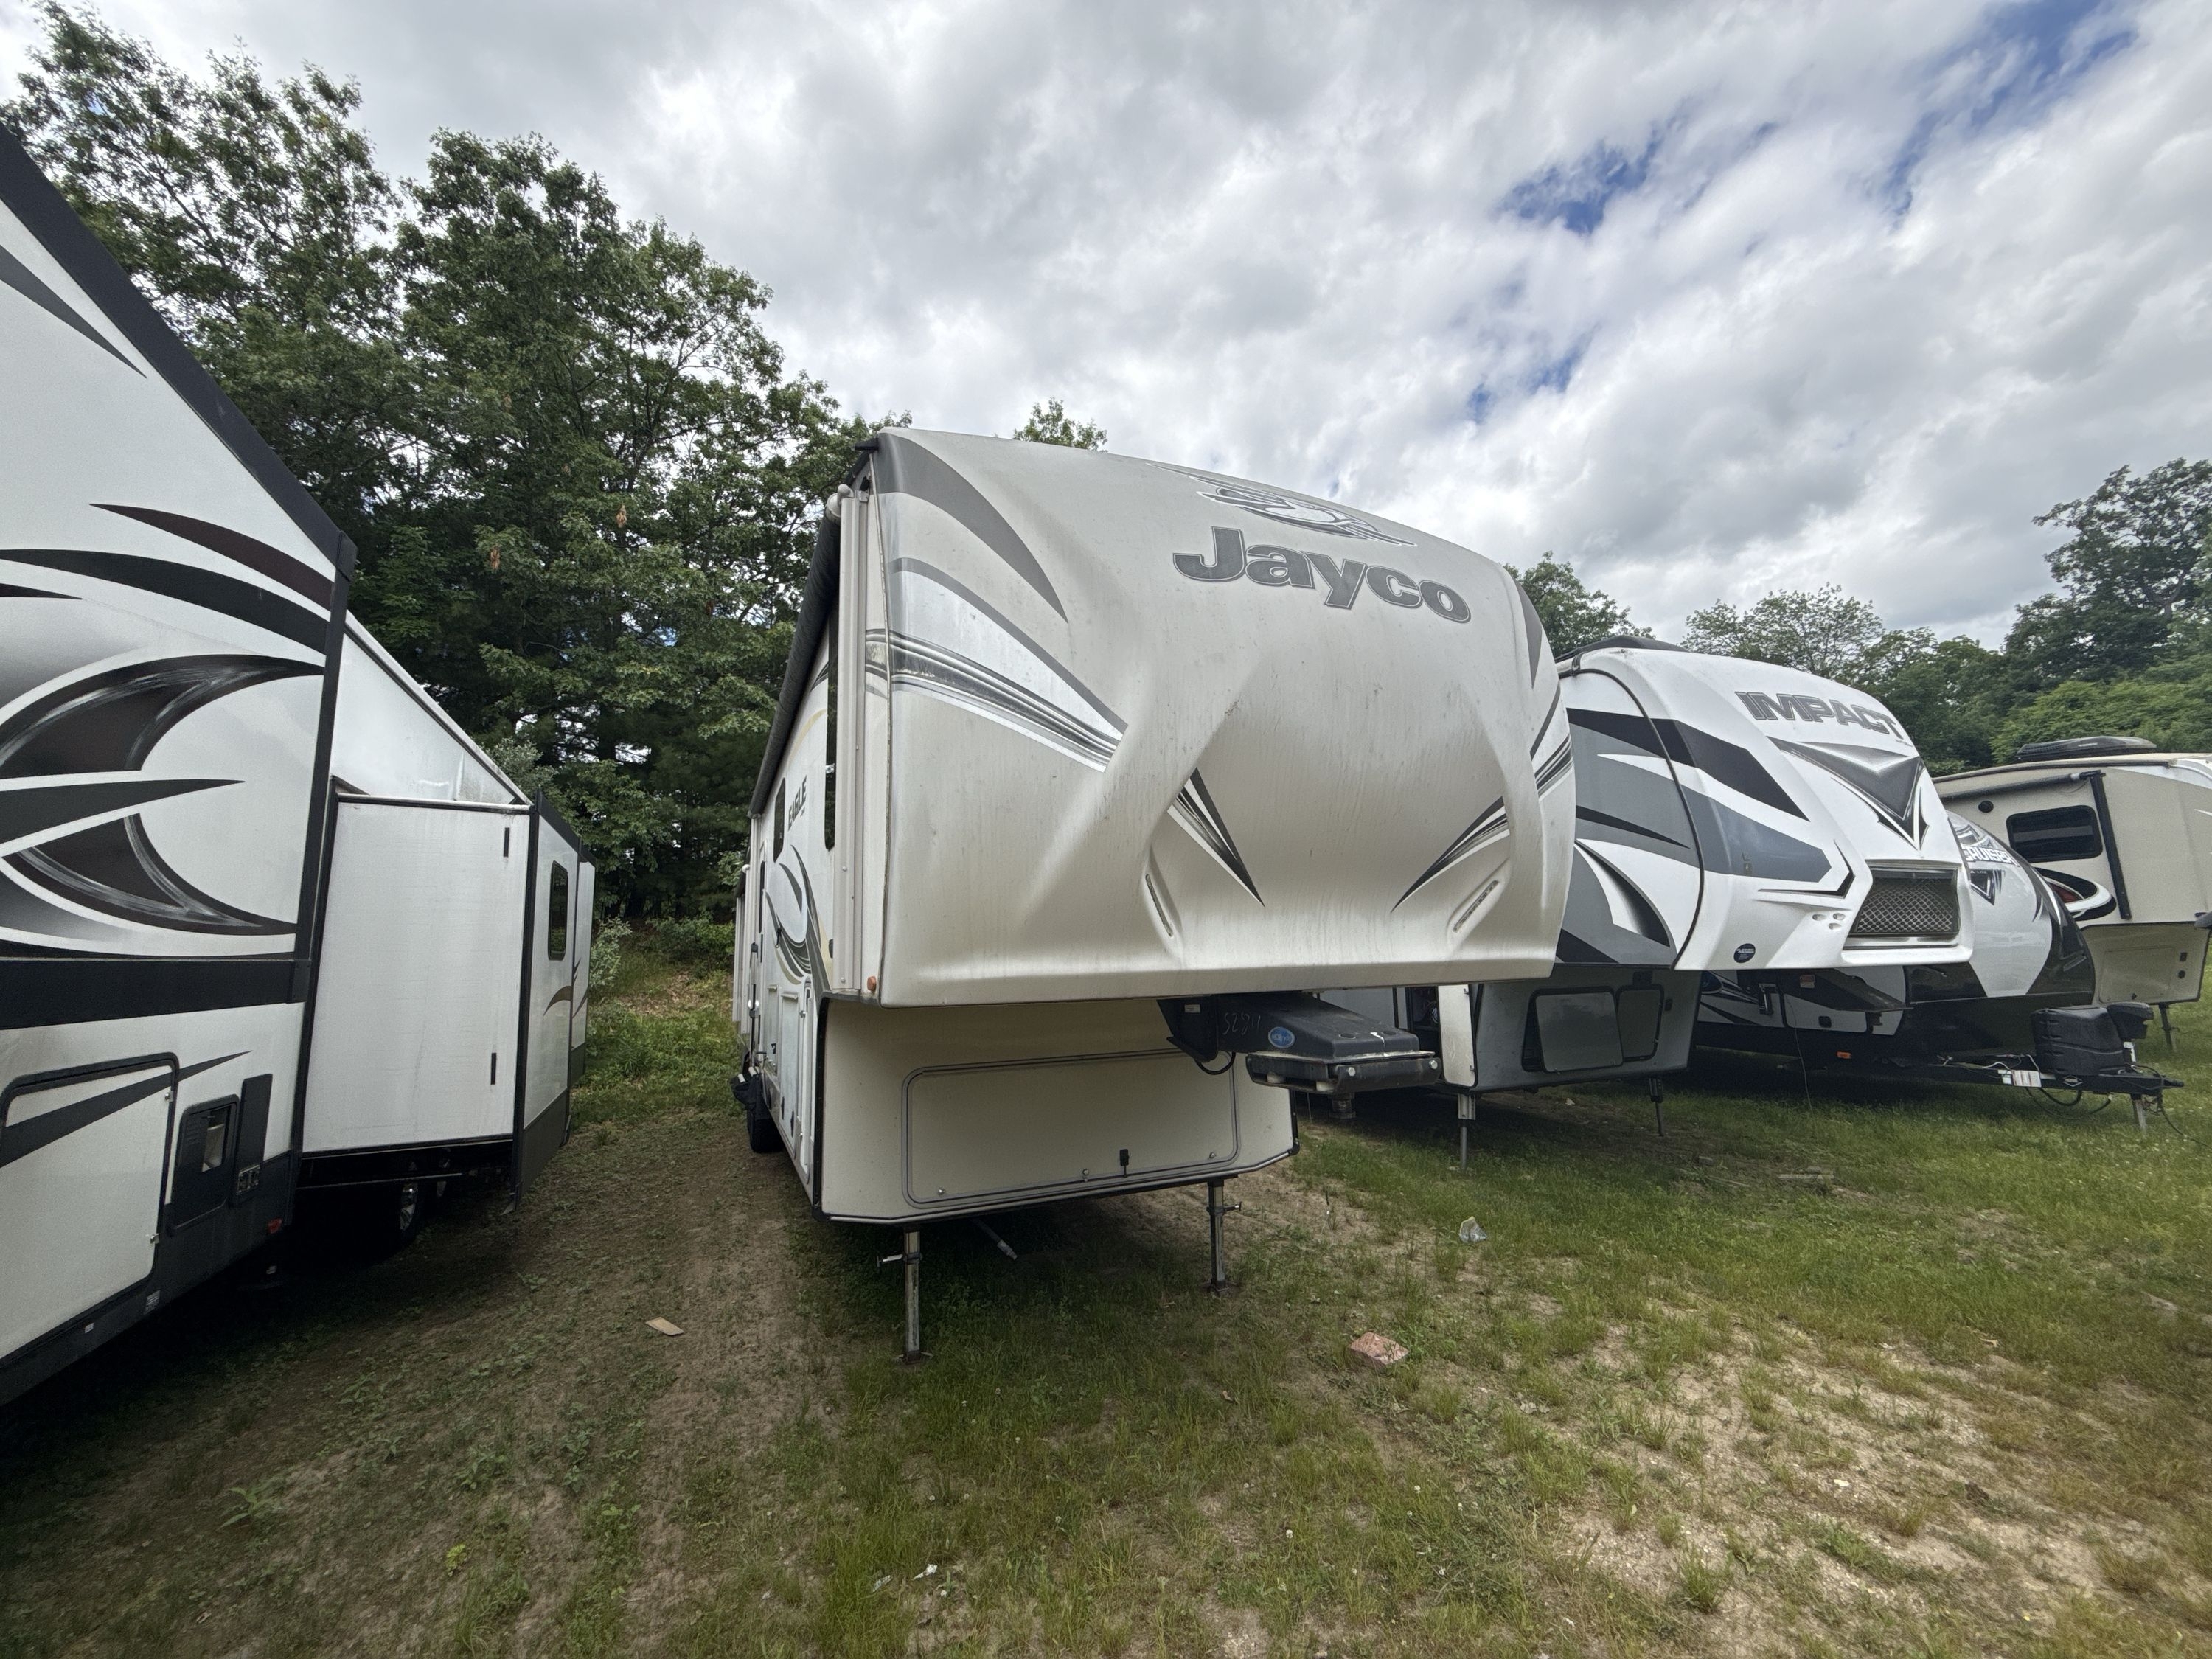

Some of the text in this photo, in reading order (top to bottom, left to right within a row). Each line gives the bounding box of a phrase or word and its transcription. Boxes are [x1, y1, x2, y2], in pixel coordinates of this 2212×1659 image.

[1173, 526, 1471, 623] Jayco
[1734, 690, 1905, 740] IMPACT
[787, 774, 807, 832] EAGLE
